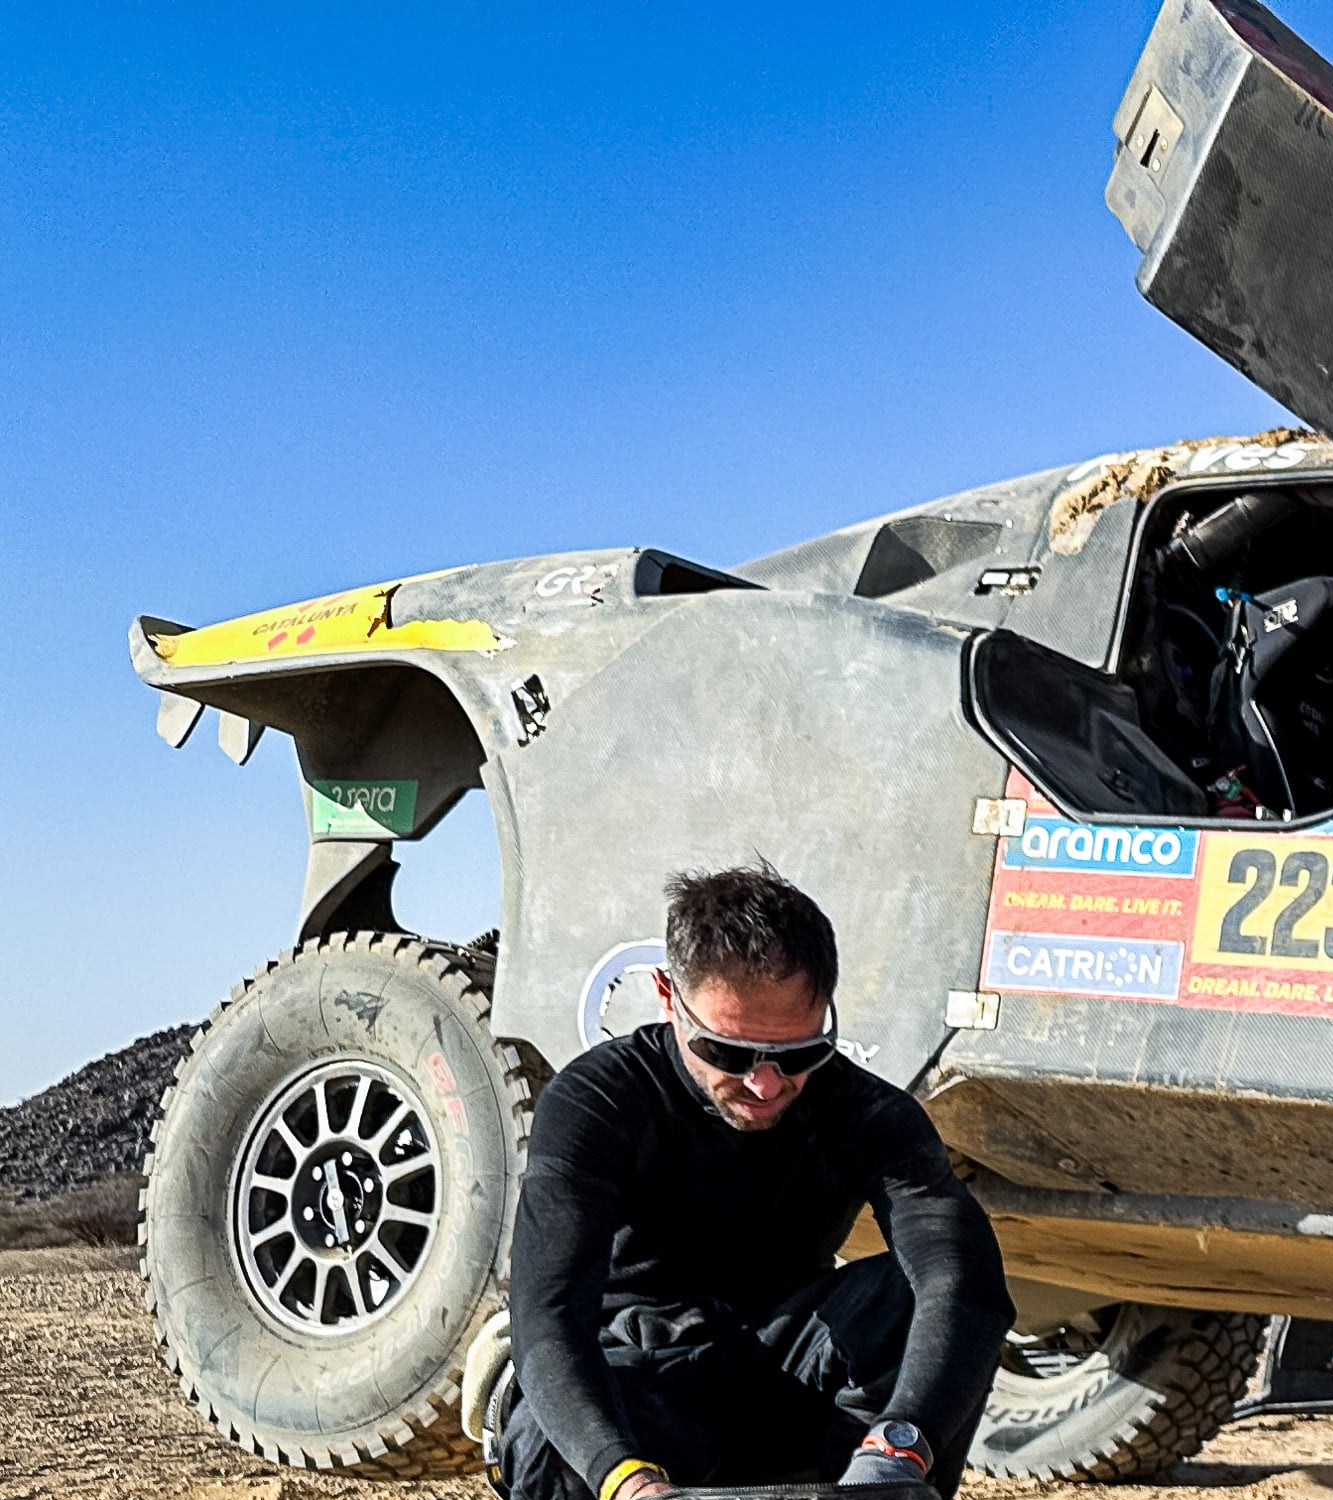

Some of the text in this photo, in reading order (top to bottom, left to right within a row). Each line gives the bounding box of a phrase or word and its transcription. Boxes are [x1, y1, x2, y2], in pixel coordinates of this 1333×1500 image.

[252, 603, 358, 636] CATALUNYA
[1021, 826, 1182, 865] aramco
[1004, 891, 1183, 917] DREAM. DARE. LIVE IT.
[1007, 945, 1163, 987] CATRION
[1188, 976, 1260, 999] DREAM.
[1263, 982, 1321, 1002] DARE.
